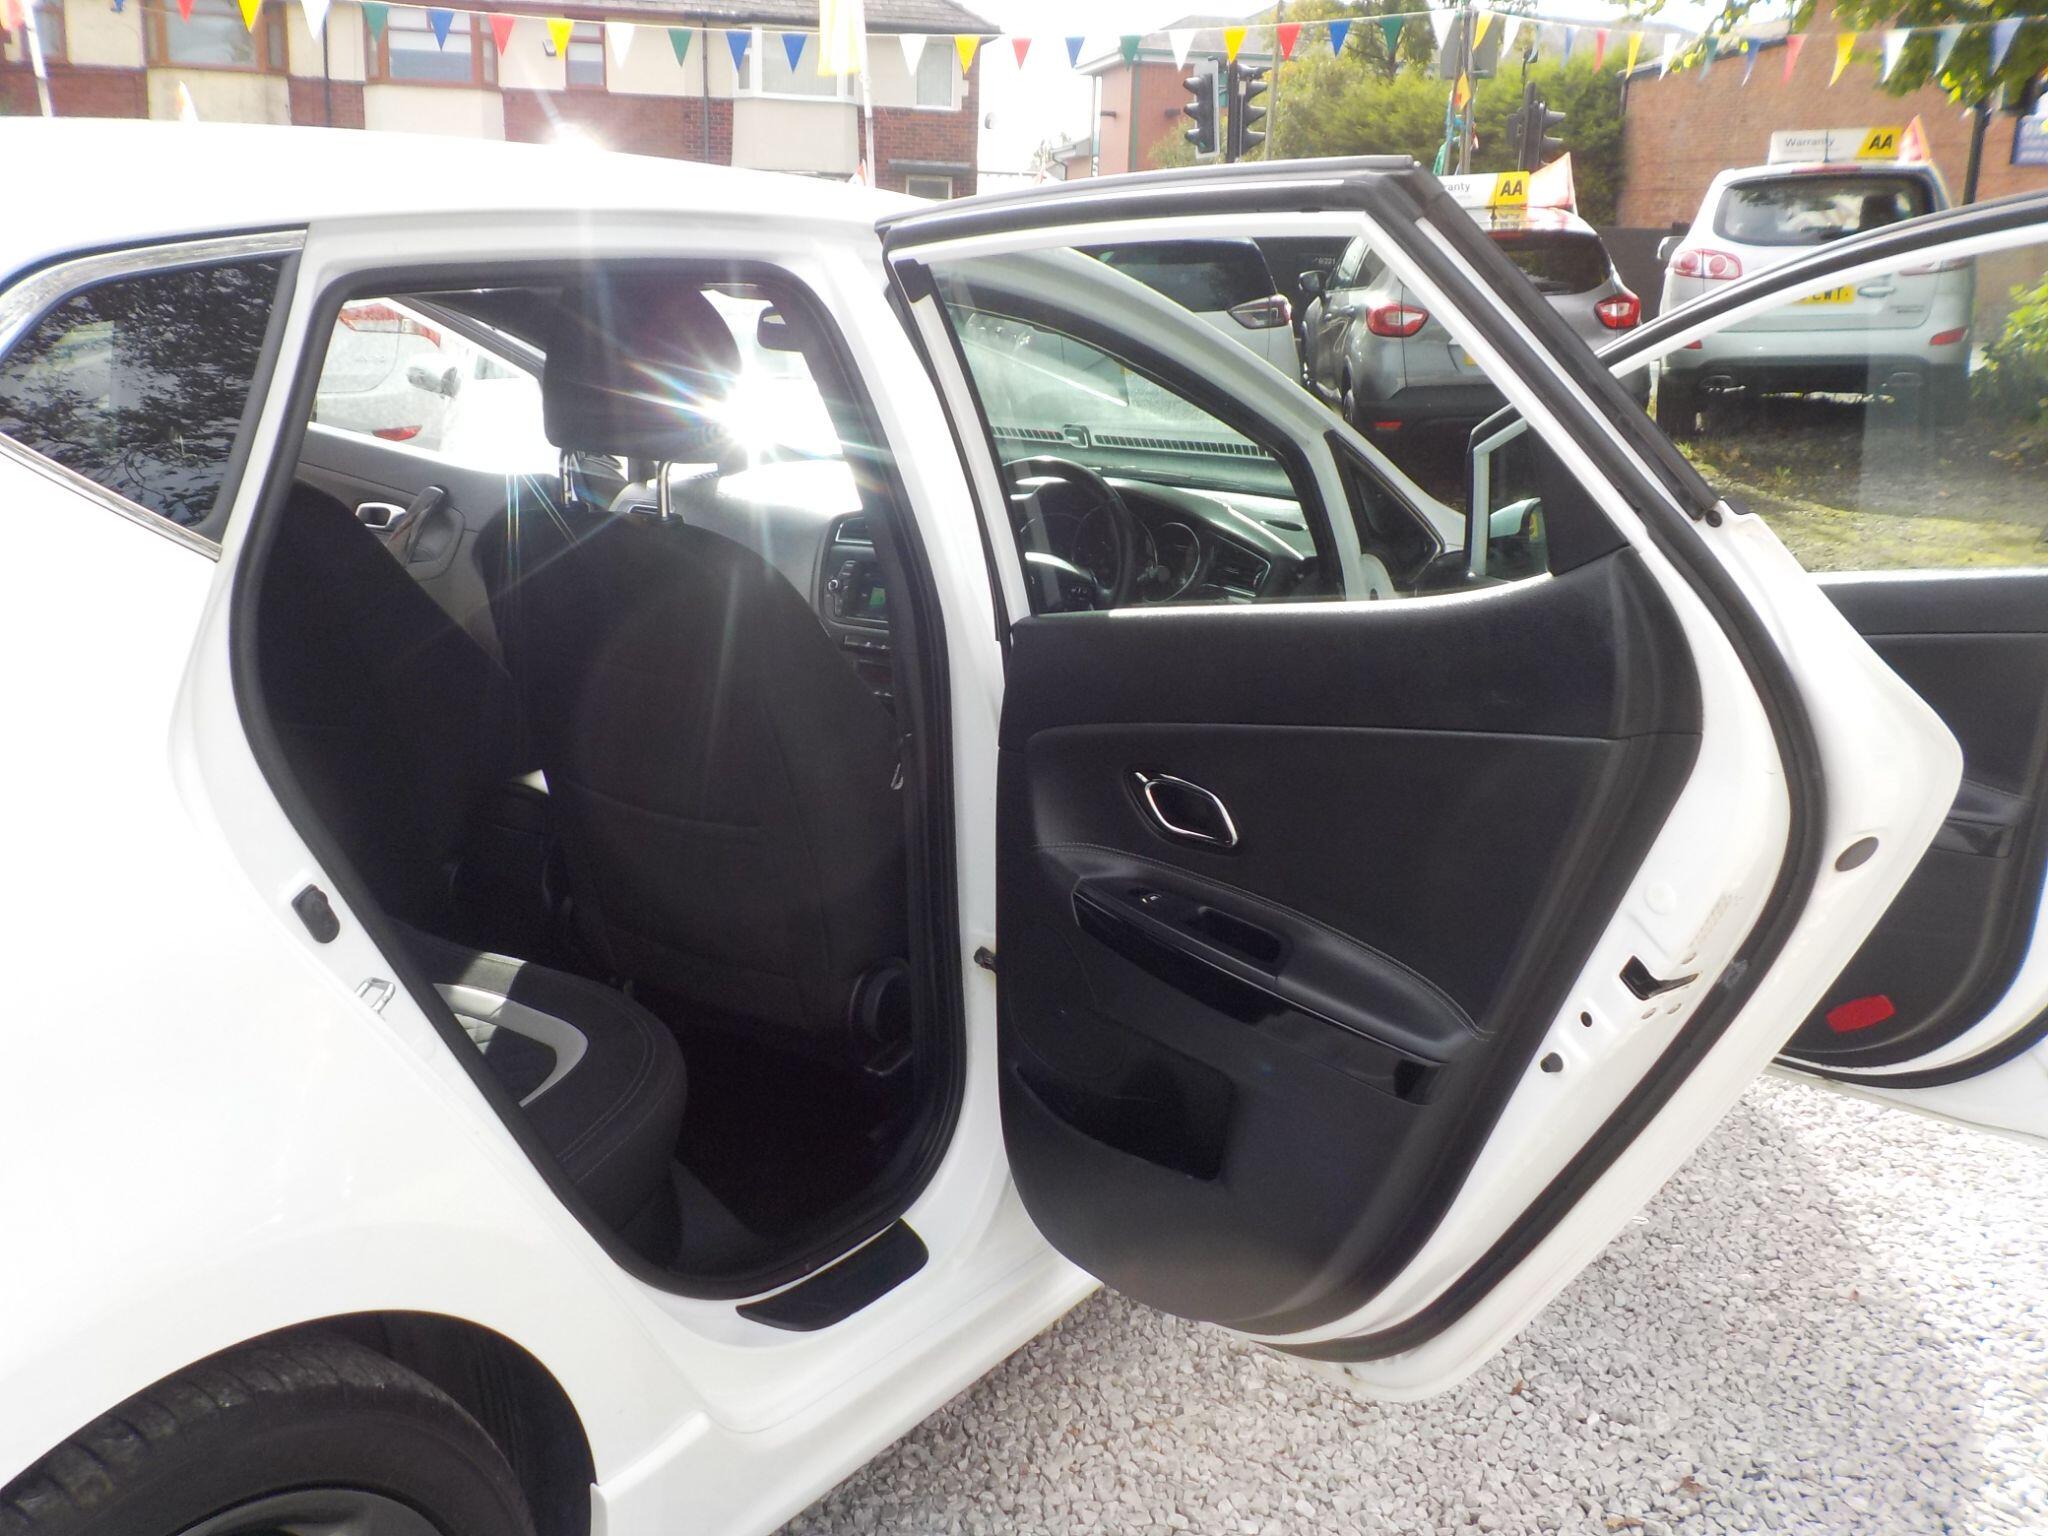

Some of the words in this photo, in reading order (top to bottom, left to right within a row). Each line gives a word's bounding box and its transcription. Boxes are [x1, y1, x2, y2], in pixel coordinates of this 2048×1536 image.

[1785, 135, 1836, 147] Warrany
[1868, 134, 1893, 150] AA
[1500, 179, 1523, 197] AA
